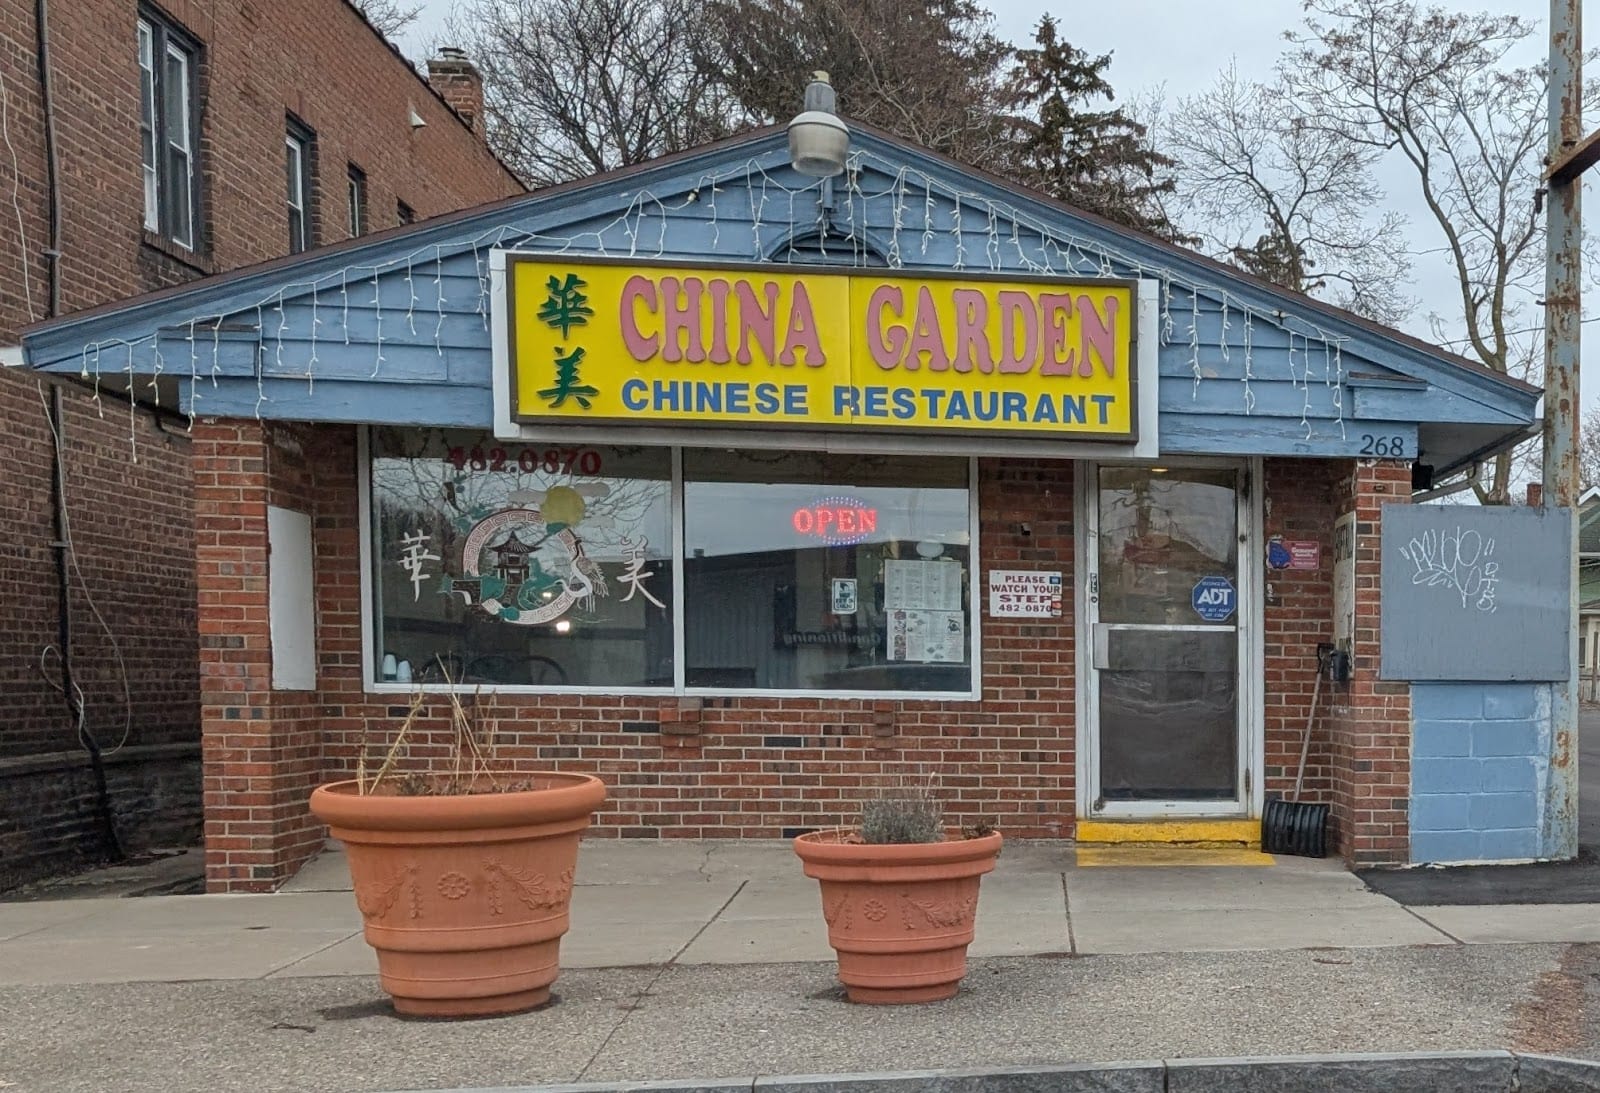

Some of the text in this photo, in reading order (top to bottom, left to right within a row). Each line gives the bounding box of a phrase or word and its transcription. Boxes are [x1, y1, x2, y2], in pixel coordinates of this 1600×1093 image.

[619, 275, 1119, 378] CHINA GARDEN
[621, 378, 1115, 425] CHINESE RESTAURANT
[1360, 434, 1404, 458] 268
[792, 506, 878, 535] OPEN
[1005, 575, 1046, 584] PLEASE
[991, 584, 1061, 594] WATCH YOUR
[1197, 588, 1233, 606] ADT
[998, 603, 1052, 612] 482-0870
[999, 594, 1052, 603] STEP
